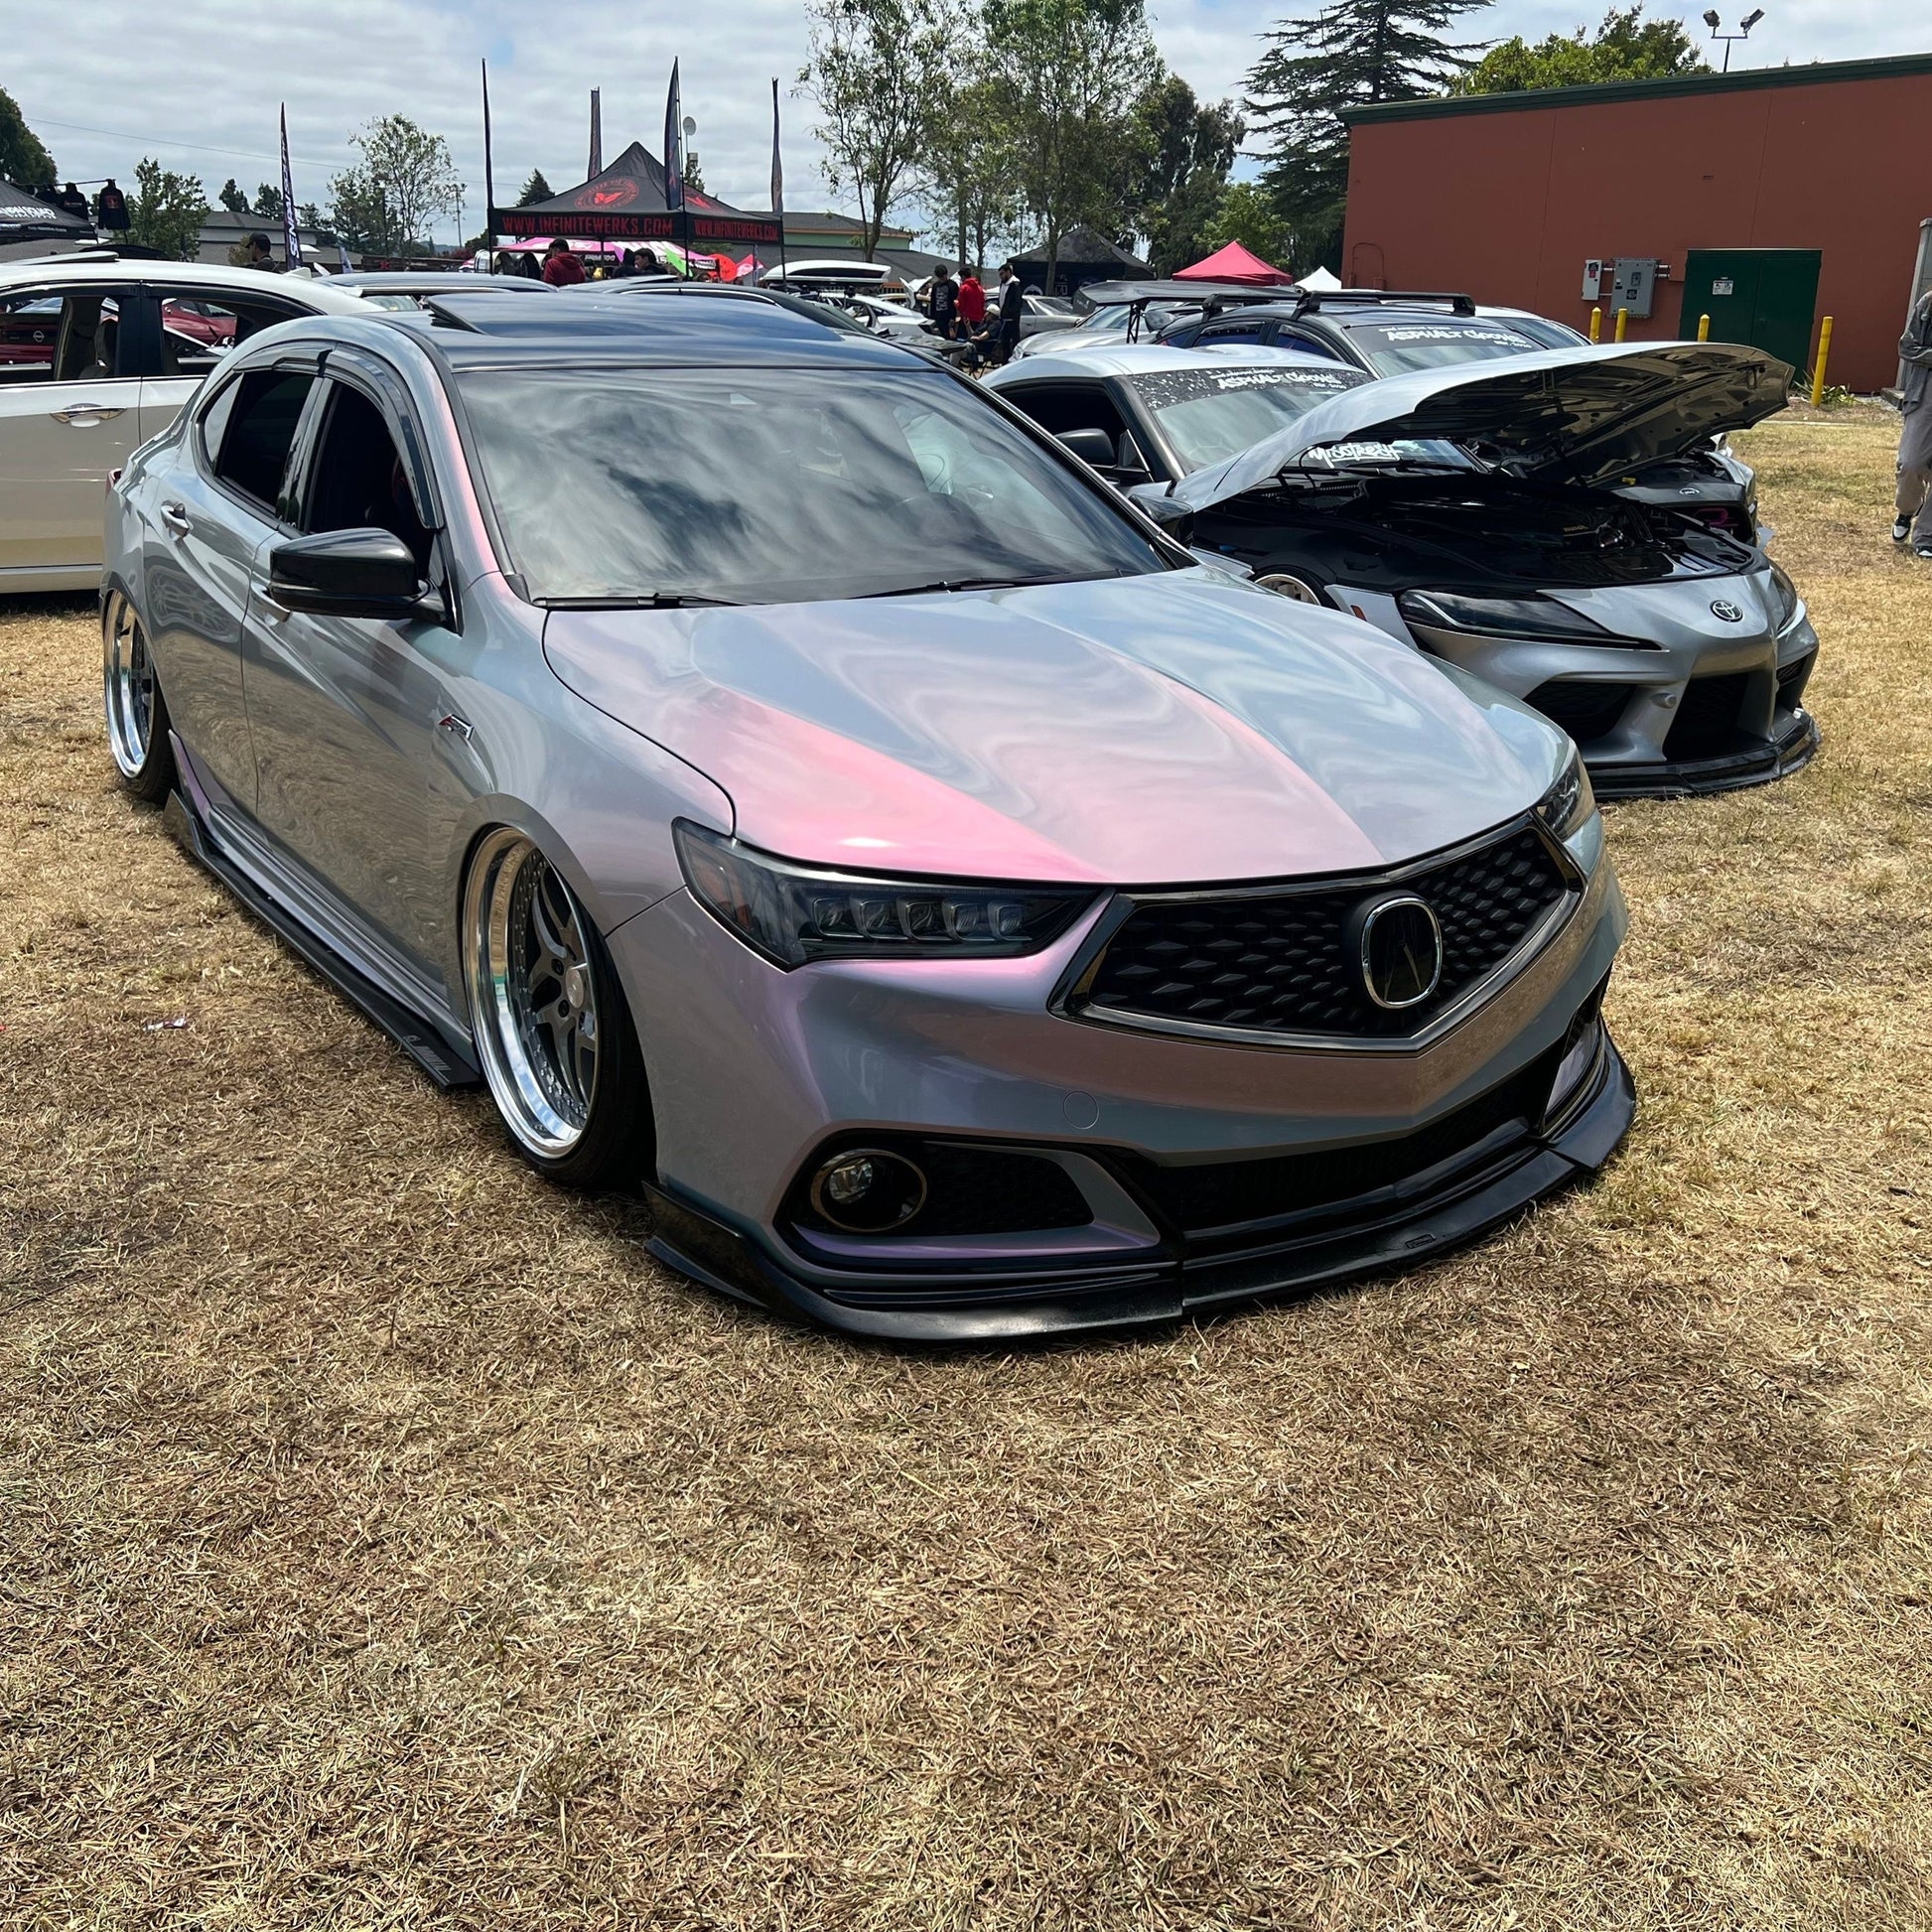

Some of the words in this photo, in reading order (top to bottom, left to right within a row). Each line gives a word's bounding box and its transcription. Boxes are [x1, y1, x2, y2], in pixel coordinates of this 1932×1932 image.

[284, 195, 300, 258] SENPAI
[502, 216, 673, 235] WWW.INFINITEWERKS.COM
[1387, 329, 1462, 341] ASPHALT
